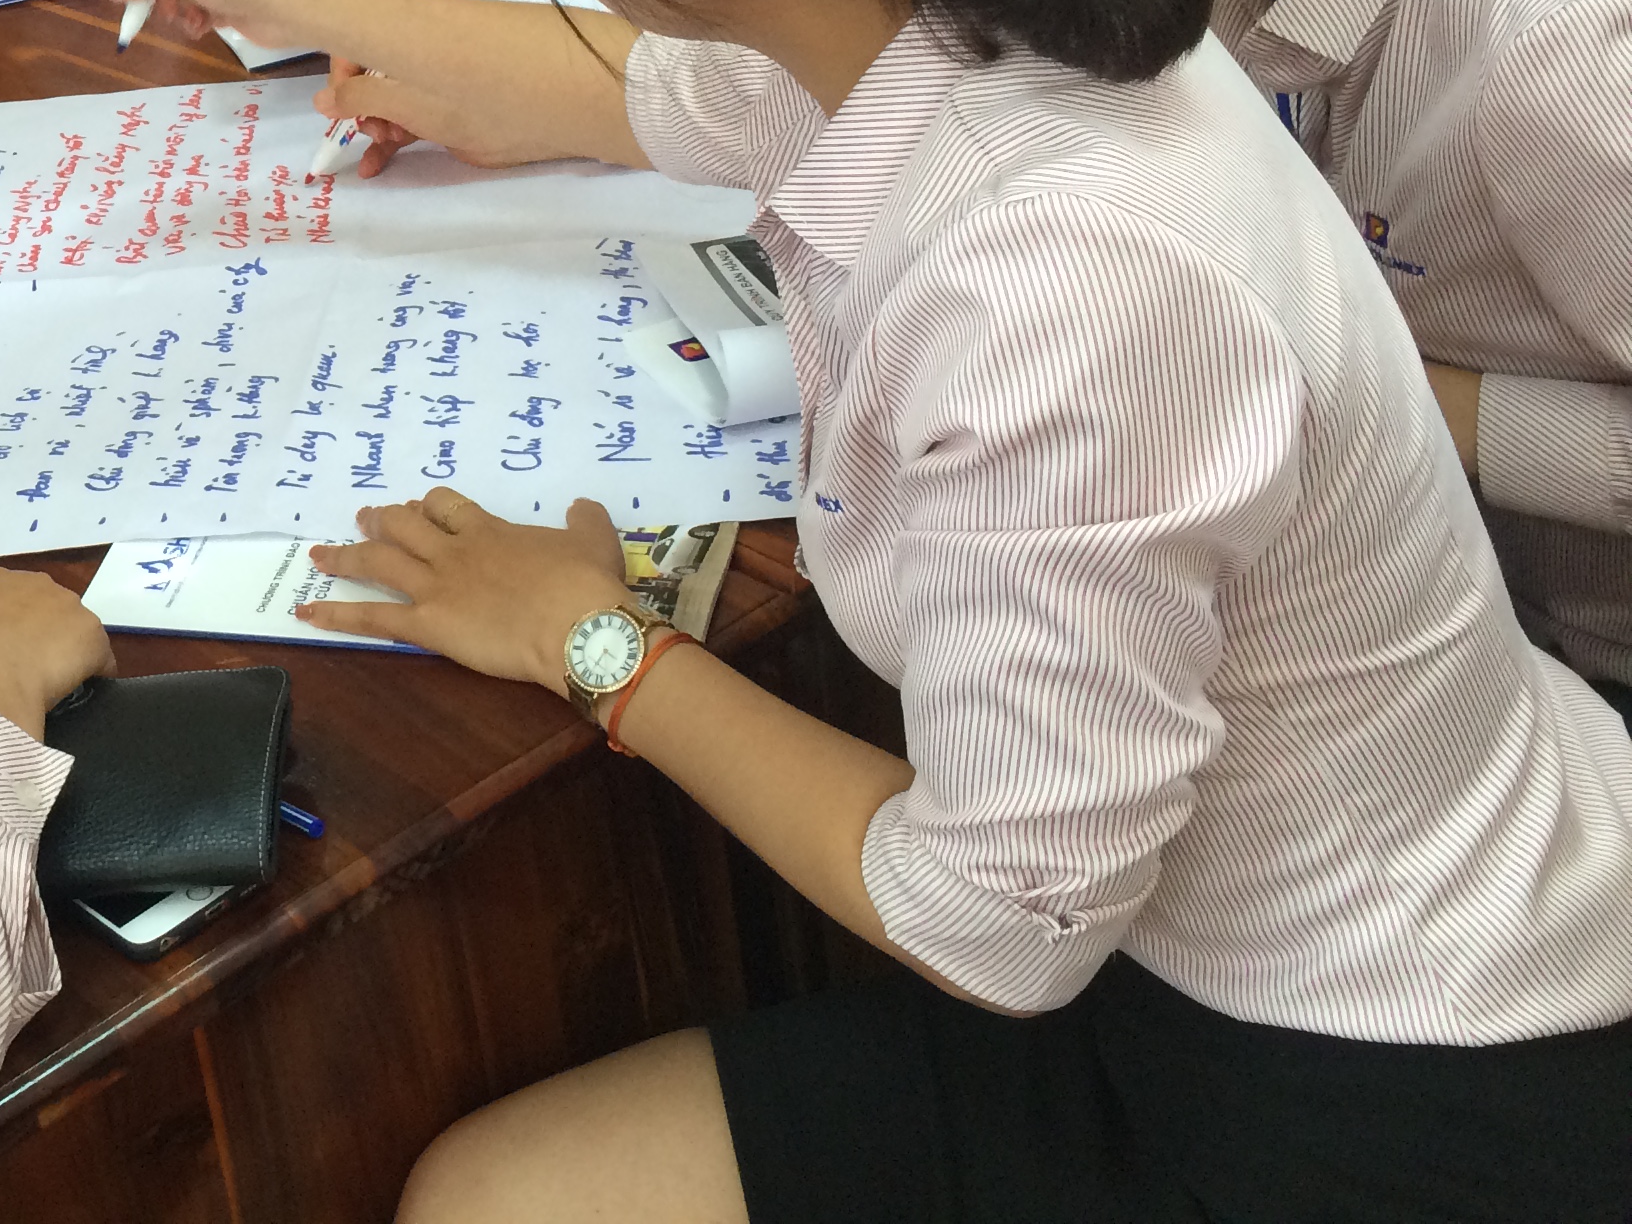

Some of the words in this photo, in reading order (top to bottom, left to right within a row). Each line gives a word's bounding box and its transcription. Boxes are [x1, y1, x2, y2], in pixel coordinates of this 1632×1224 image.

[716, 249, 739, 272] HÀNG
[284, 430, 337, 463] duy
[256, 580, 276, 613] CHƯƠNG
[273, 559, 291, 582] TRÌNH
